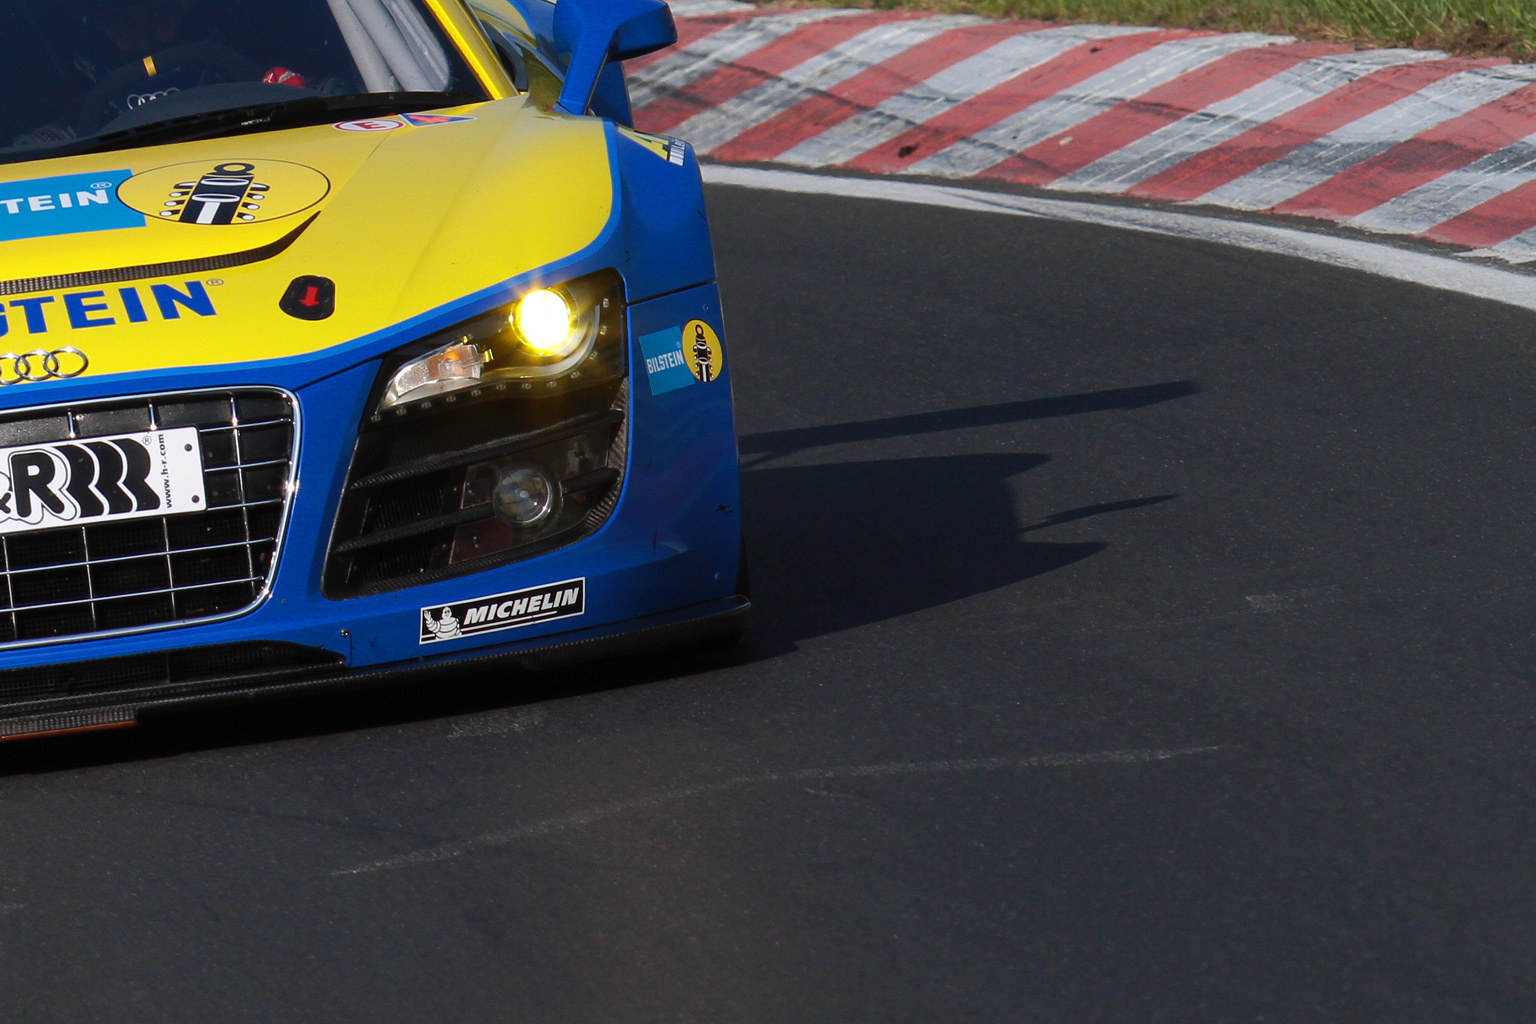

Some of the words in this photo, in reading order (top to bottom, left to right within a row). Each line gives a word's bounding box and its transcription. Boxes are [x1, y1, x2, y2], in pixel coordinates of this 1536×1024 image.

[646, 349, 685, 374] BILSTEIN
[158, 433, 173, 509] www.h-r.com
[463, 587, 580, 626] MICHELIN
